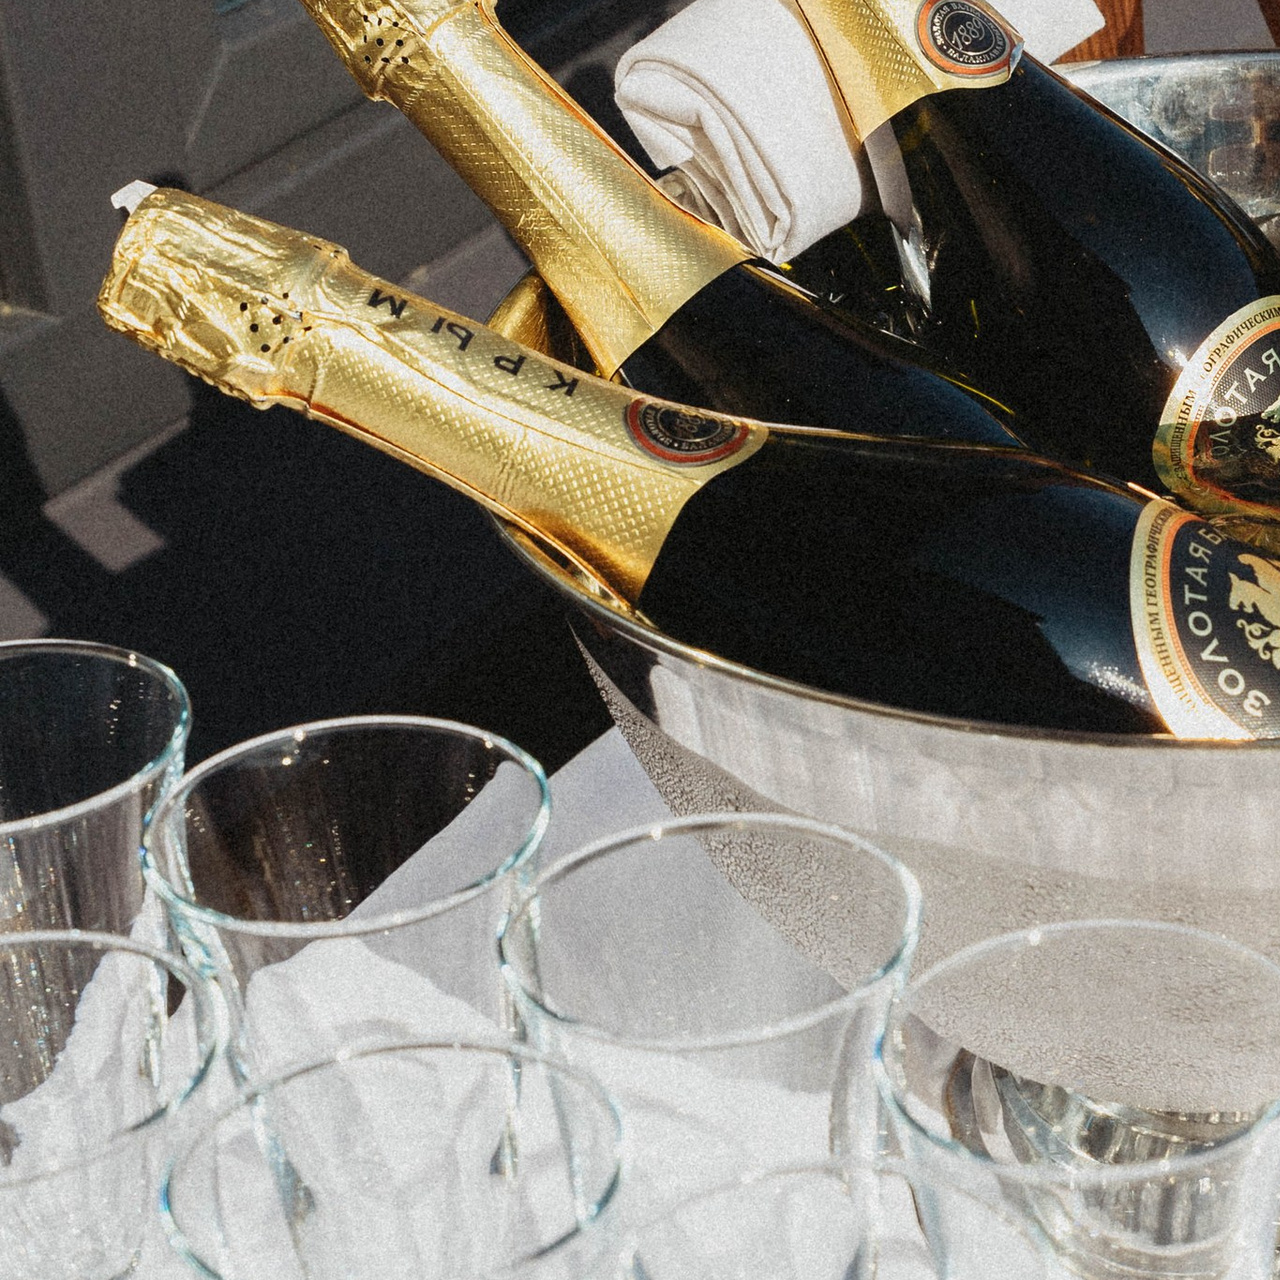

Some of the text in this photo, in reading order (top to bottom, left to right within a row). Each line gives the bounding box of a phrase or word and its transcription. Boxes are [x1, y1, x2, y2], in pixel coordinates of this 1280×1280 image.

[952, 16, 985, 51] 1889
[366, 287, 580, 397] КРЫМ
[1184, 542, 1271, 718] ЗОЛОТАЯ
